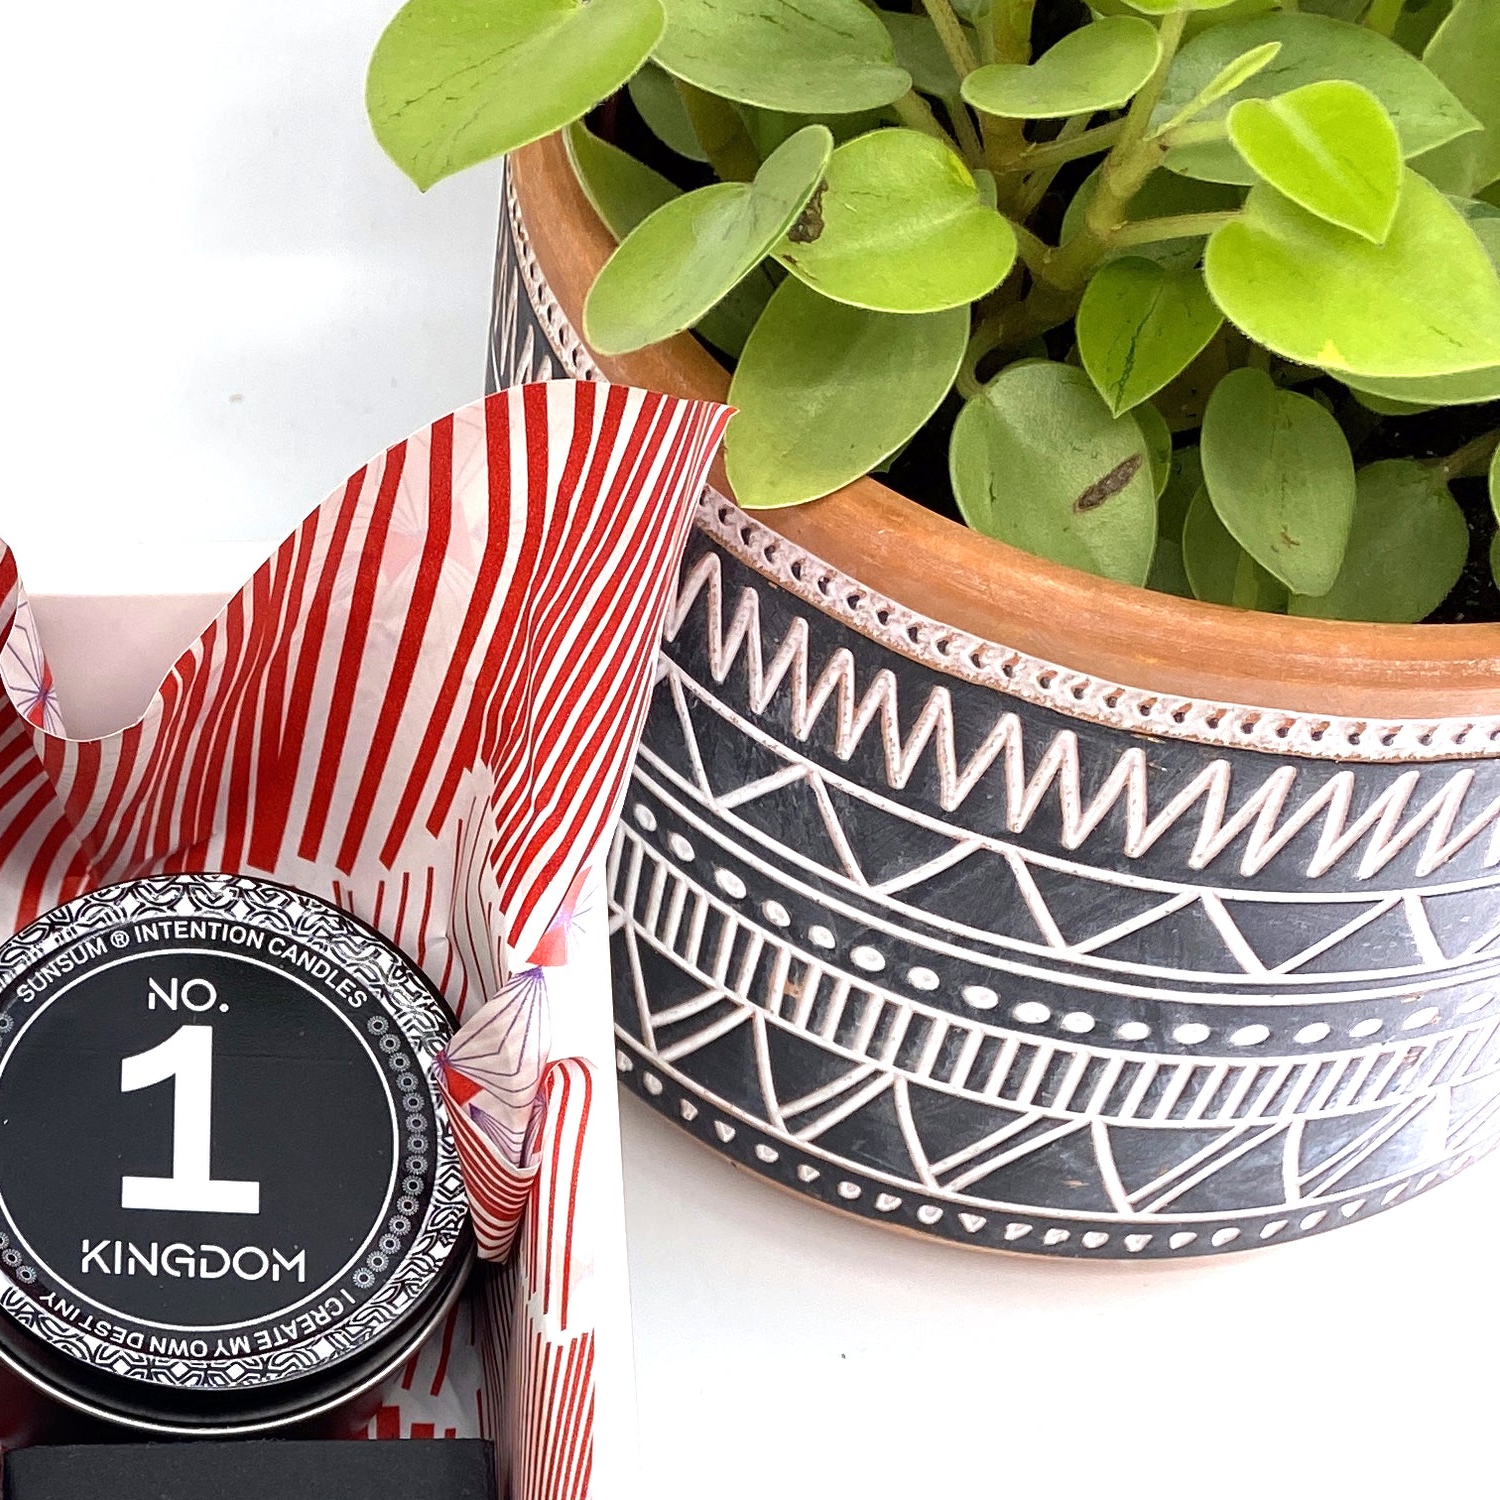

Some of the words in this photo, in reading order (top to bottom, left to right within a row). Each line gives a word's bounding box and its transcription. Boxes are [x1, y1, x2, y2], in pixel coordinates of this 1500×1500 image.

[16, 938, 108, 1003] SUNSUM
[135, 920, 263, 948] INTENTION
[268, 937, 368, 1009] CANDLES
[148, 977, 230, 1012] NO.
[121, 1024, 260, 1214] 1
[80, 1238, 306, 1283] KINGDOM
[342, 1288, 356, 1305] I
[255, 1296, 344, 1349] CREATE
[150, 1336, 208, 1357] OWN
[215, 1336, 250, 1357] MY
